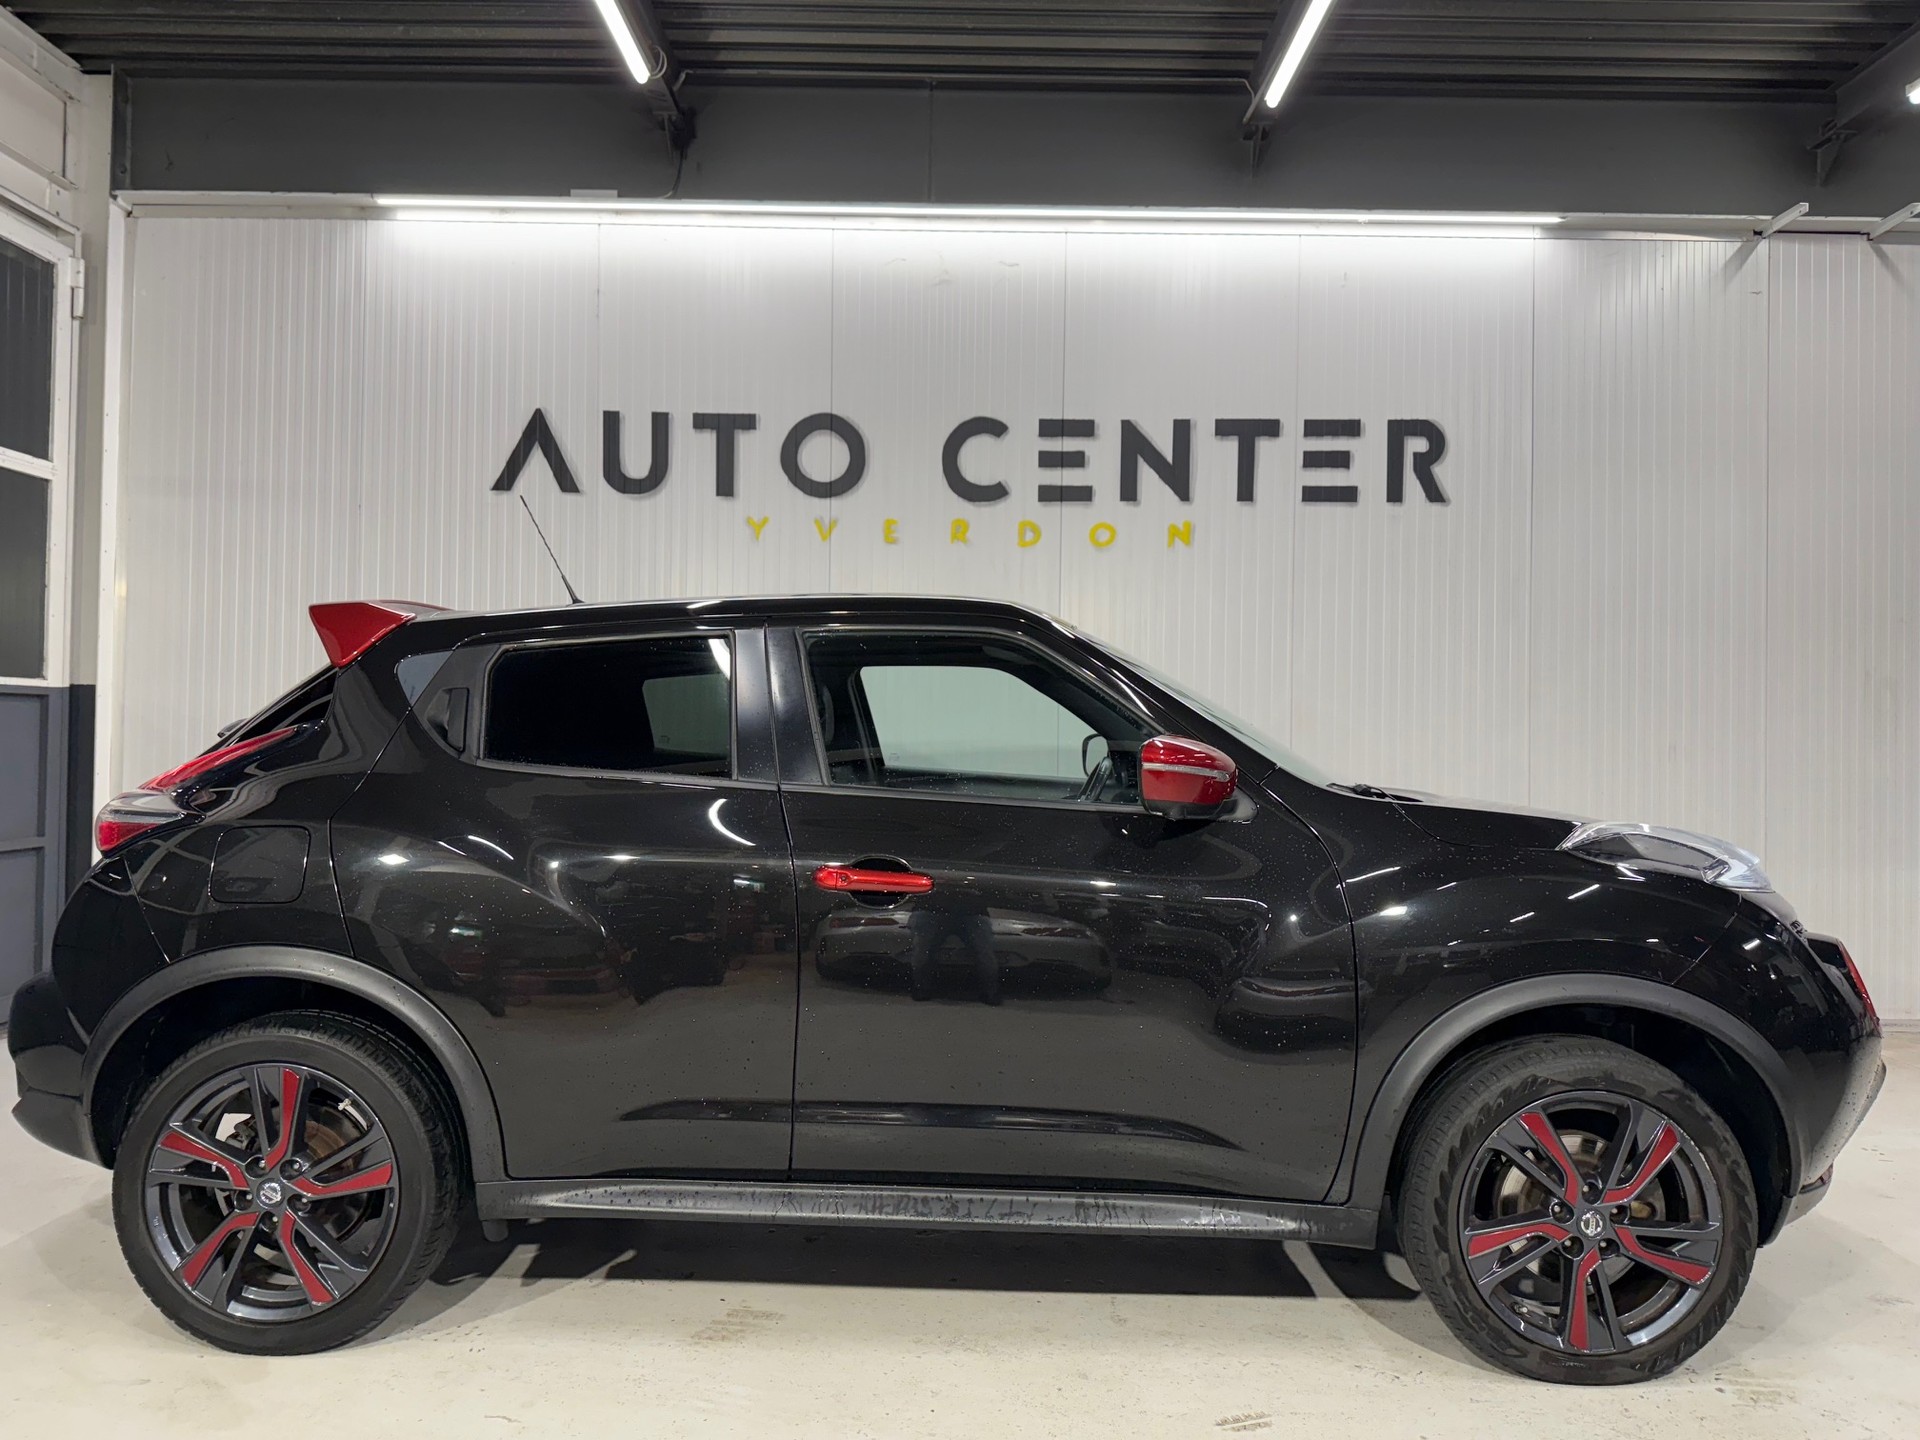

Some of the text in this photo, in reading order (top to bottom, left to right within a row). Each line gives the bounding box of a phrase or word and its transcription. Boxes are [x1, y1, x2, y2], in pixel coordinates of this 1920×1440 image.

[491, 408, 1448, 503] AUTO CENTER
[747, 516, 1193, 548] YVERDON
